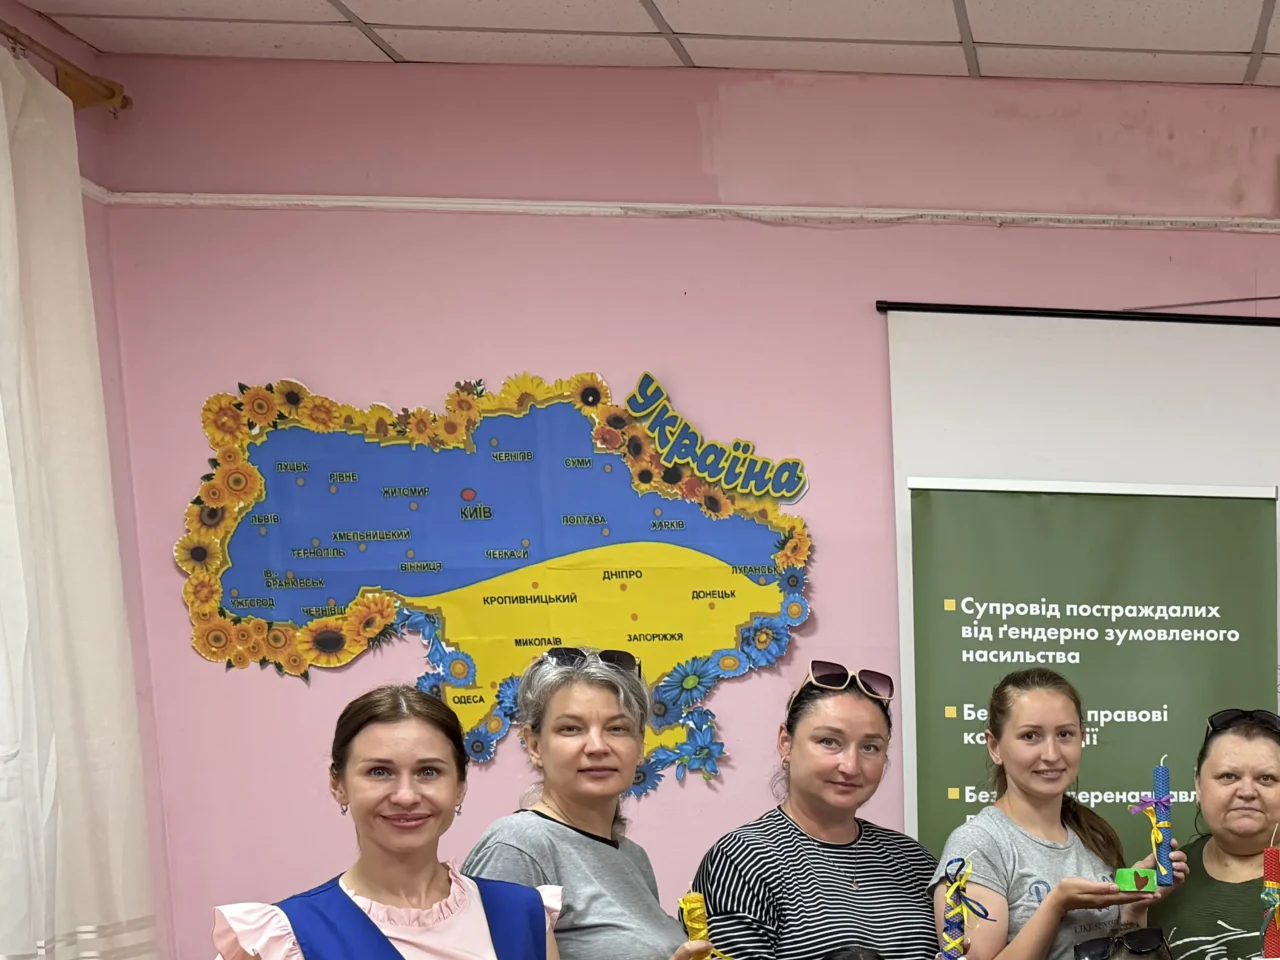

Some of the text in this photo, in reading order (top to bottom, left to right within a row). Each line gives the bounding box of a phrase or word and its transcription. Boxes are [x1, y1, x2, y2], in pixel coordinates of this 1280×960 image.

[625, 371, 806, 497] Україна
[275, 461, 310, 473] ЛУЦЬК
[564, 457, 593, 469] СУМИ
[329, 472, 359, 483] РІВНЕ
[381, 486, 431, 498] ЖИТОМИР
[460, 504, 493, 521] КИЇВ
[251, 513, 281, 525] ЛЬВІВ
[562, 514, 608, 526] ПОЛТАВА
[650, 519, 686, 531] ХАРКІВ
[332, 527, 411, 542] ХМЕЛЬНИЦЬКИЙ
[291, 547, 346, 559] ТЕРНОПІЛЬ
[485, 549, 530, 560] ЧЕРКАСИ
[400, 561, 443, 573] ВІННИЦЯ
[602, 569, 643, 581] ДНІПРО
[264, 578, 326, 589] ФРАНКІВСЬК
[483, 592, 578, 606] КРОПИВНИЦЬКИЙ
[691, 589, 736, 601] ДОНЕЦЬК
[230, 597, 276, 609] УЖГОРОД
[960, 596, 1222, 622] Супровід постраждалих
[626, 632, 684, 643] ЗАПОРІЖЖЯ
[961, 619, 1240, 646] від ґендерно зумовленого
[514, 636, 563, 648] МИКОЛАЇВ
[962, 647, 1081, 665] насильства
[452, 694, 486, 705] ОДЕСА
[1087, 704, 1169, 727] правові
